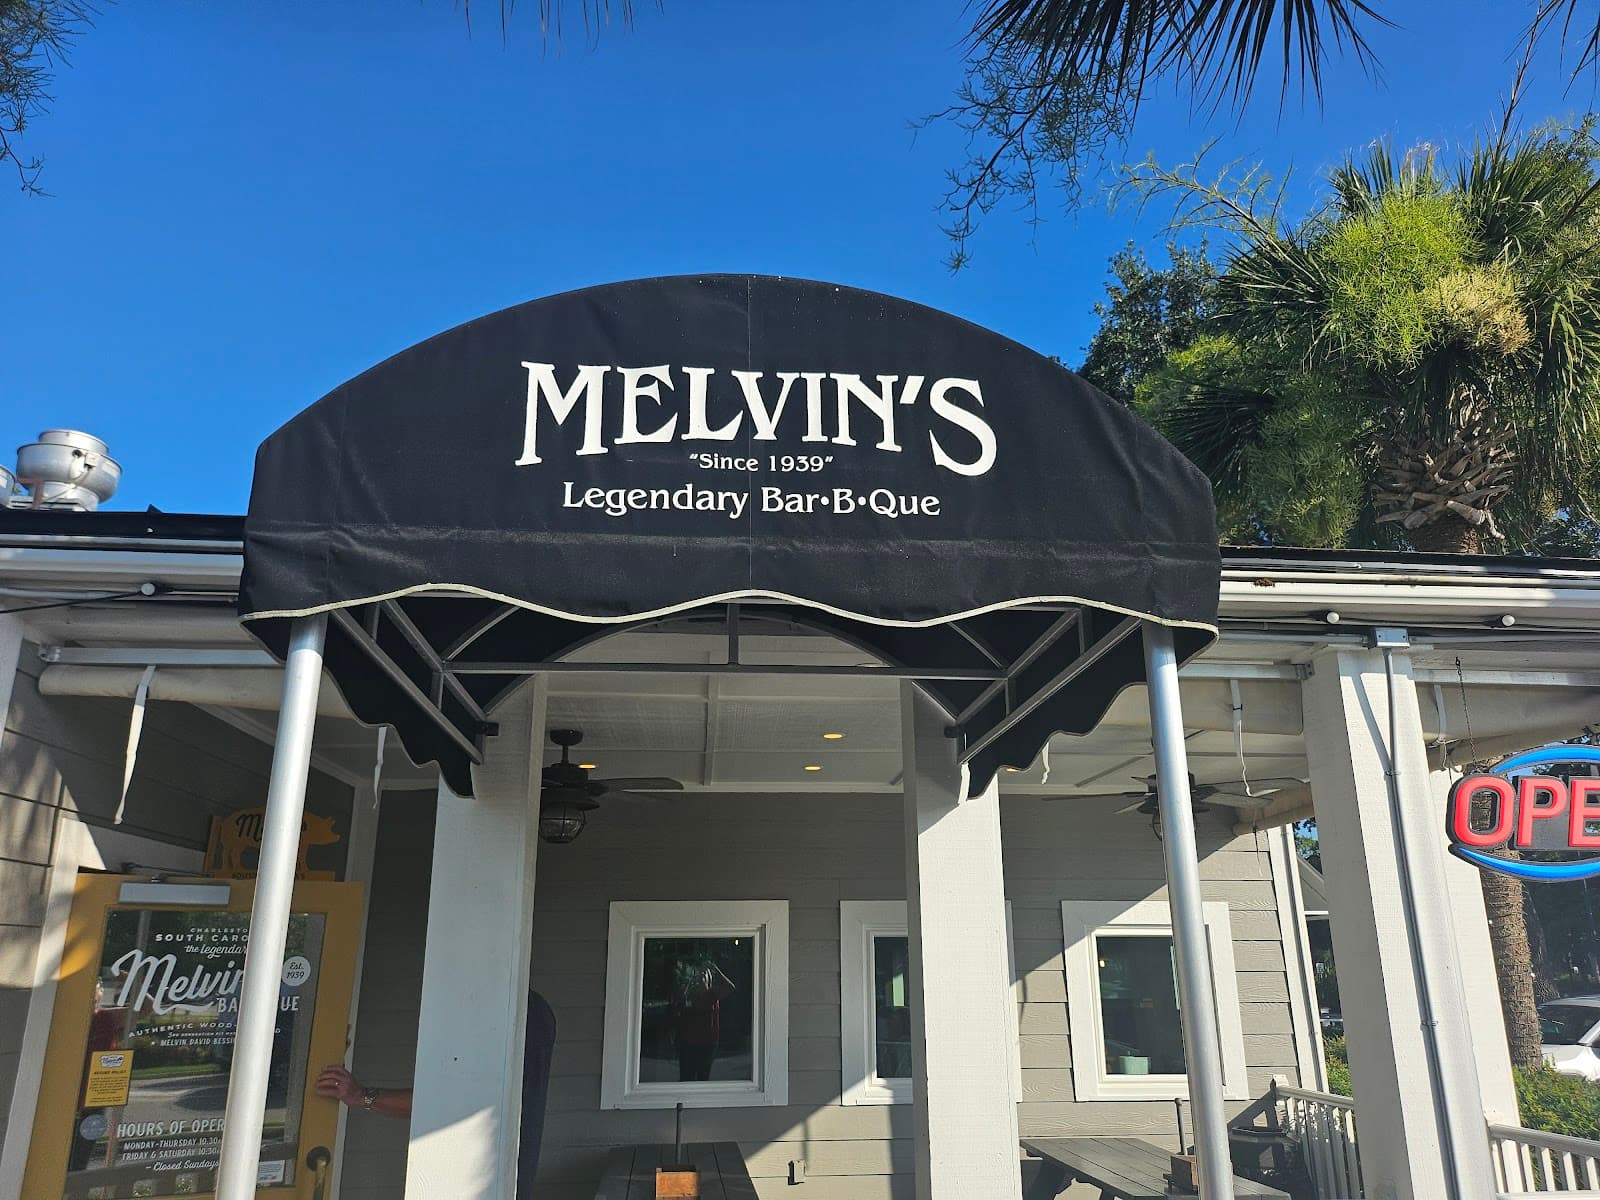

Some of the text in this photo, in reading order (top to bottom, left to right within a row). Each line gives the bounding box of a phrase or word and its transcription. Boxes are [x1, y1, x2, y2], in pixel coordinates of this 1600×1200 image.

[514, 360, 997, 477] MELVIN'S
[562, 481, 749, 519] Legendary
[1454, 776, 1600, 847] OPE
[155, 934, 249, 942] SOUTH CARO
[184, 944, 200, 953] the
[286, 971, 305, 979] 1939
[128, 1022, 194, 1038] AUTHENTIC
[159, 1036, 234, 1046] MELVIN DAVID BESSI
[116, 1121, 164, 1138] HOURS
[169, 1119, 188, 1135] OF
[124, 1138, 197, 1150] MONDAY-THURSDAY
[122, 1151, 149, 1161] FRIDAY
[150, 1151, 157, 1160] &
[159, 1148, 196, 1159] SATURDAY
[153, 1161, 182, 1171] Closed
